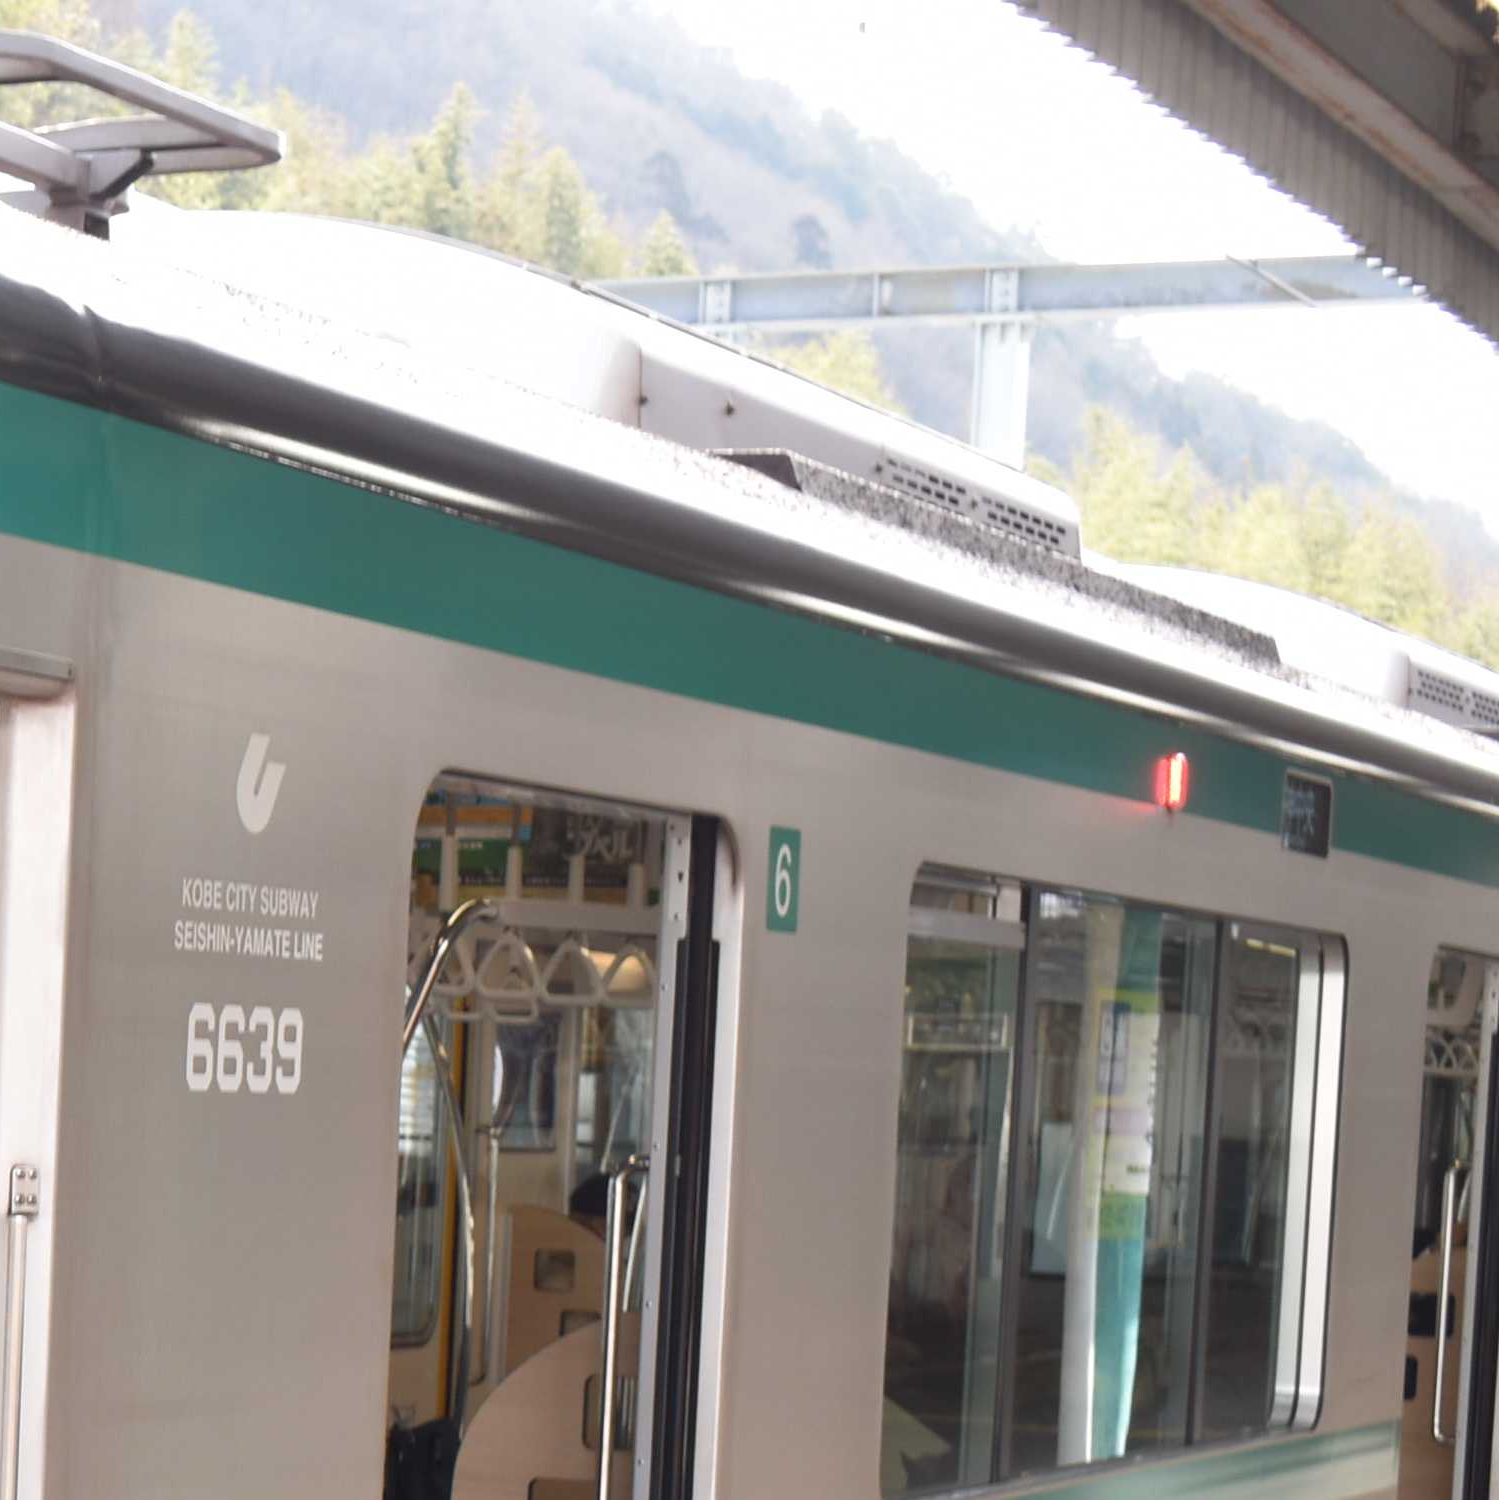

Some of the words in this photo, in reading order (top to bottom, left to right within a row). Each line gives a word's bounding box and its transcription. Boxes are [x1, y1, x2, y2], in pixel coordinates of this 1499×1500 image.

[182, 878, 222, 910] KOBE
[225, 882, 258, 914] CITY
[259, 885, 319, 918] SUBWAY
[774, 843, 793, 918] 6
[174, 919, 291, 958] SEISHIN-YAMATE
[293, 932, 323, 961] LINE
[185, 1002, 304, 1094] 6639
